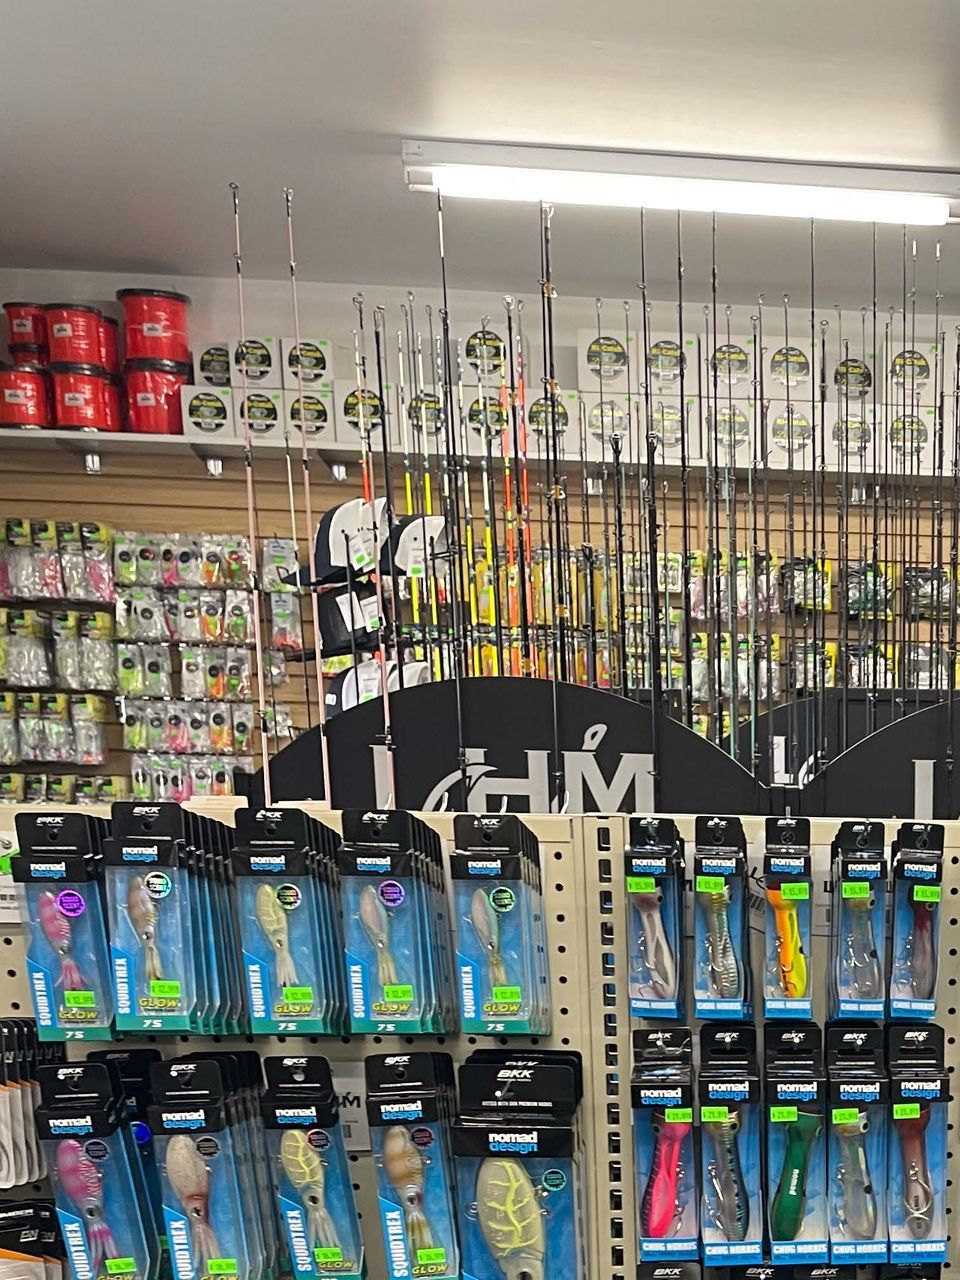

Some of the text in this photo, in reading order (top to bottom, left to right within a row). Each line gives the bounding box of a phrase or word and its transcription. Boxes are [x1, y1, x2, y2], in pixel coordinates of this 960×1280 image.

[123, 846, 157, 855] nomad
[123, 853, 157, 862] design
[632, 858, 666, 866] nomad
[633, 865, 666, 874] design
[114, 958, 130, 1014] SQUIDTREX
[461, 965, 474, 1018] SQUIDTREX
[139, 998, 178, 1008] GLOW
[142, 1020, 162, 1028] 75
[641, 1088, 681, 1097] nomad
[641, 1096, 682, 1107] design
[49, 1116, 92, 1127] nomad
[51, 1125, 91, 1135] design
[489, 1131, 537, 1143] nomad
[489, 1141, 538, 1154] design
[385, 1210, 408, 1277] SQUIDTREX
[892, 1244, 945, 1253] CHUG NORRIS
[773, 1245, 827, 1254] CHUG NORRIS
[413, 1264, 448, 1275] GLOW
